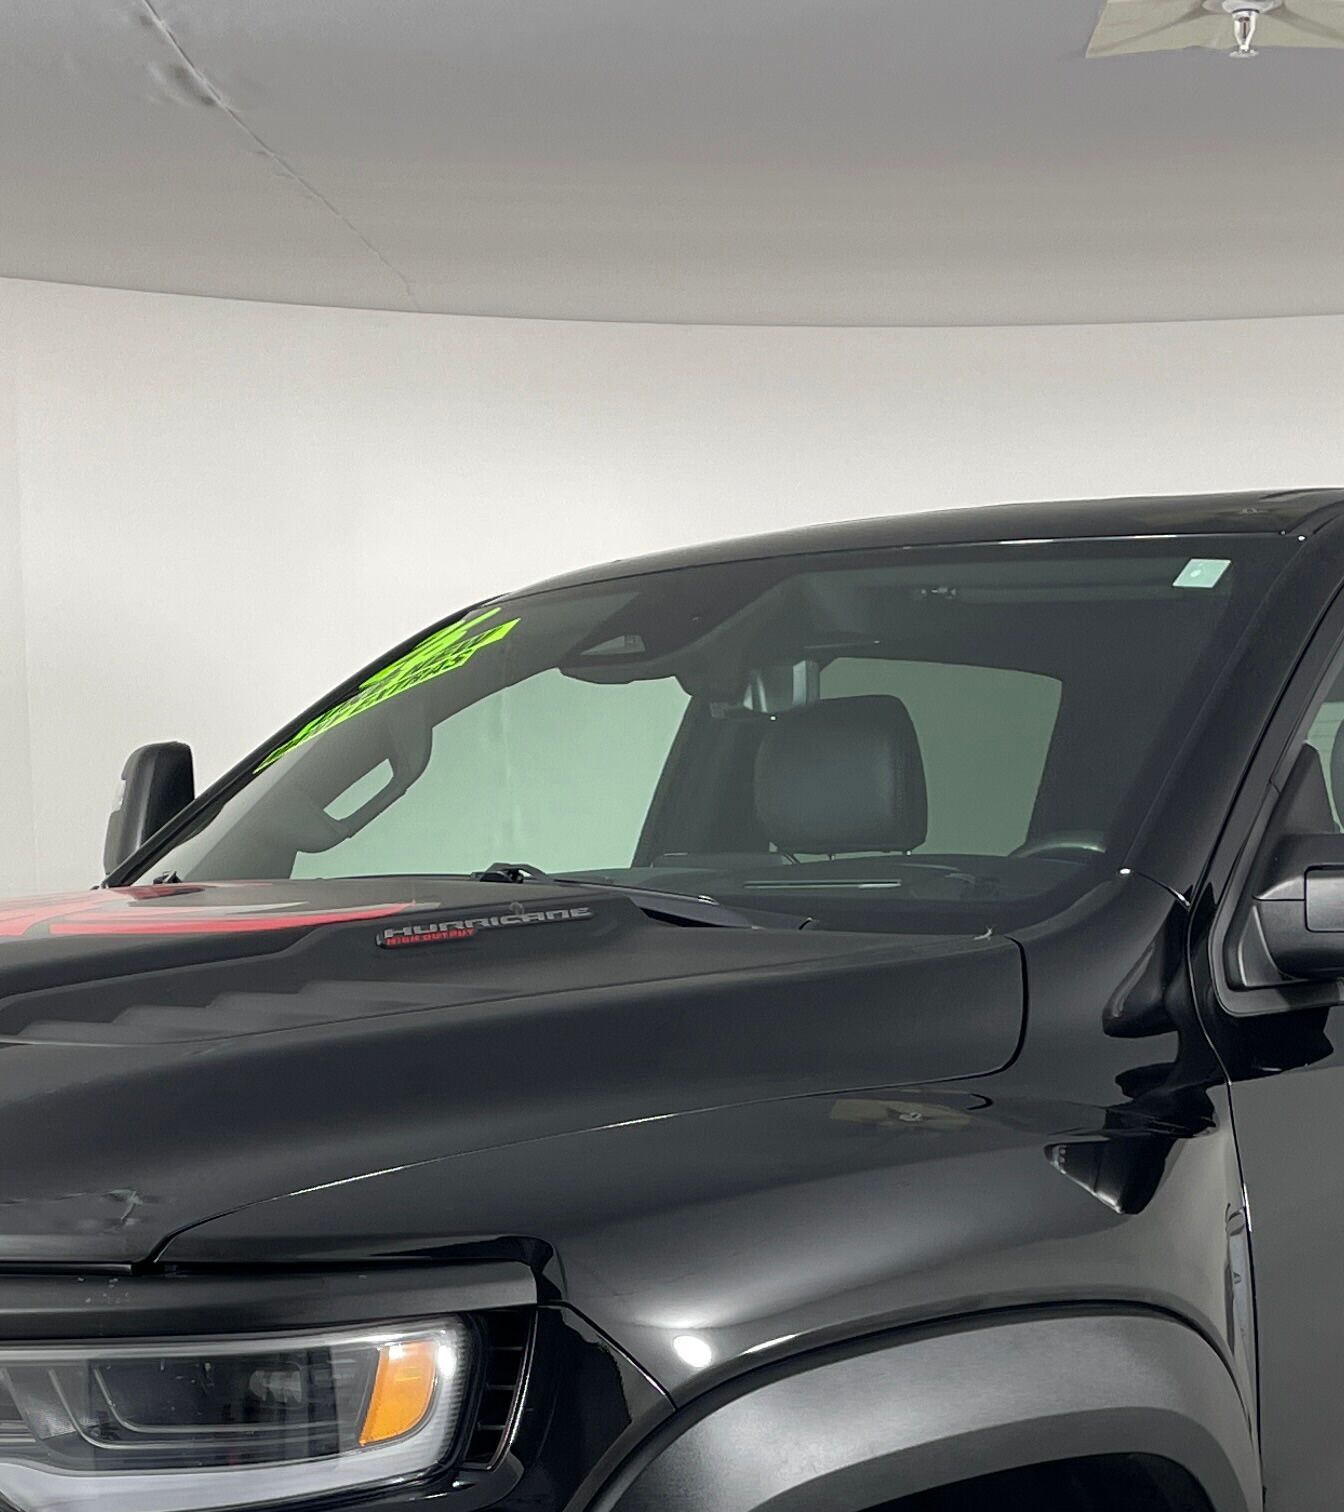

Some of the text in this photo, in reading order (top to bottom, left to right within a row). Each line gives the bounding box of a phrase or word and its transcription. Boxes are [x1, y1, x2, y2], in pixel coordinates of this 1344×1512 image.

[384, 907, 593, 938] HURRICANE
[386, 928, 474, 945] HIGH OUTPUT
